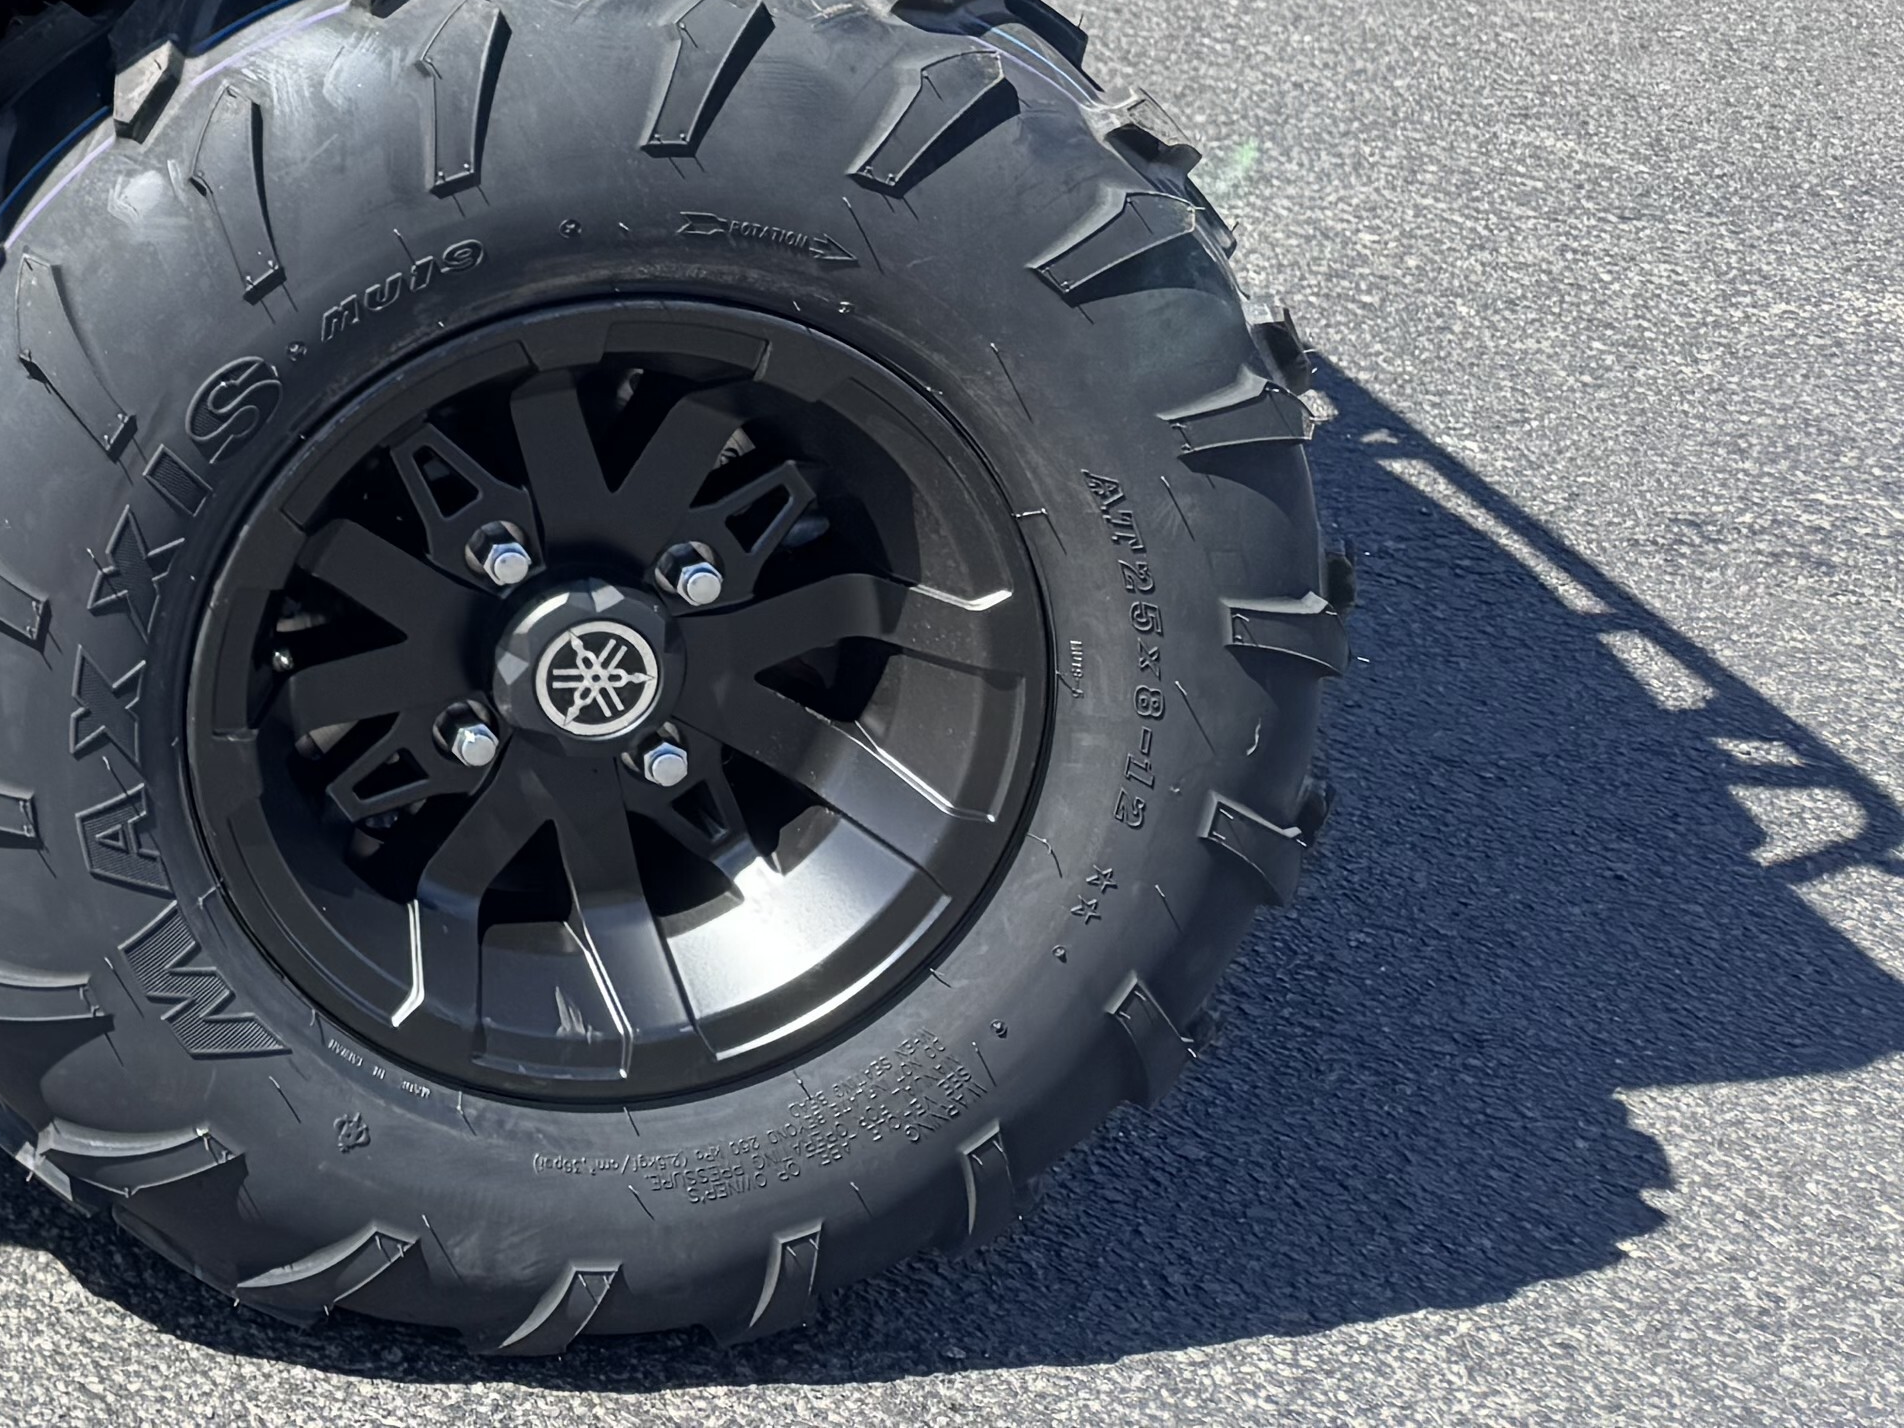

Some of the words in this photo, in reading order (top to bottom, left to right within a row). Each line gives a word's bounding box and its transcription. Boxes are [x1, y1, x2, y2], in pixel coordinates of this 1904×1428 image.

[729, 219, 809, 248] ROTATION
[318, 238, 485, 342] MU19
[76, 352, 293, 1060] MAXXIS
